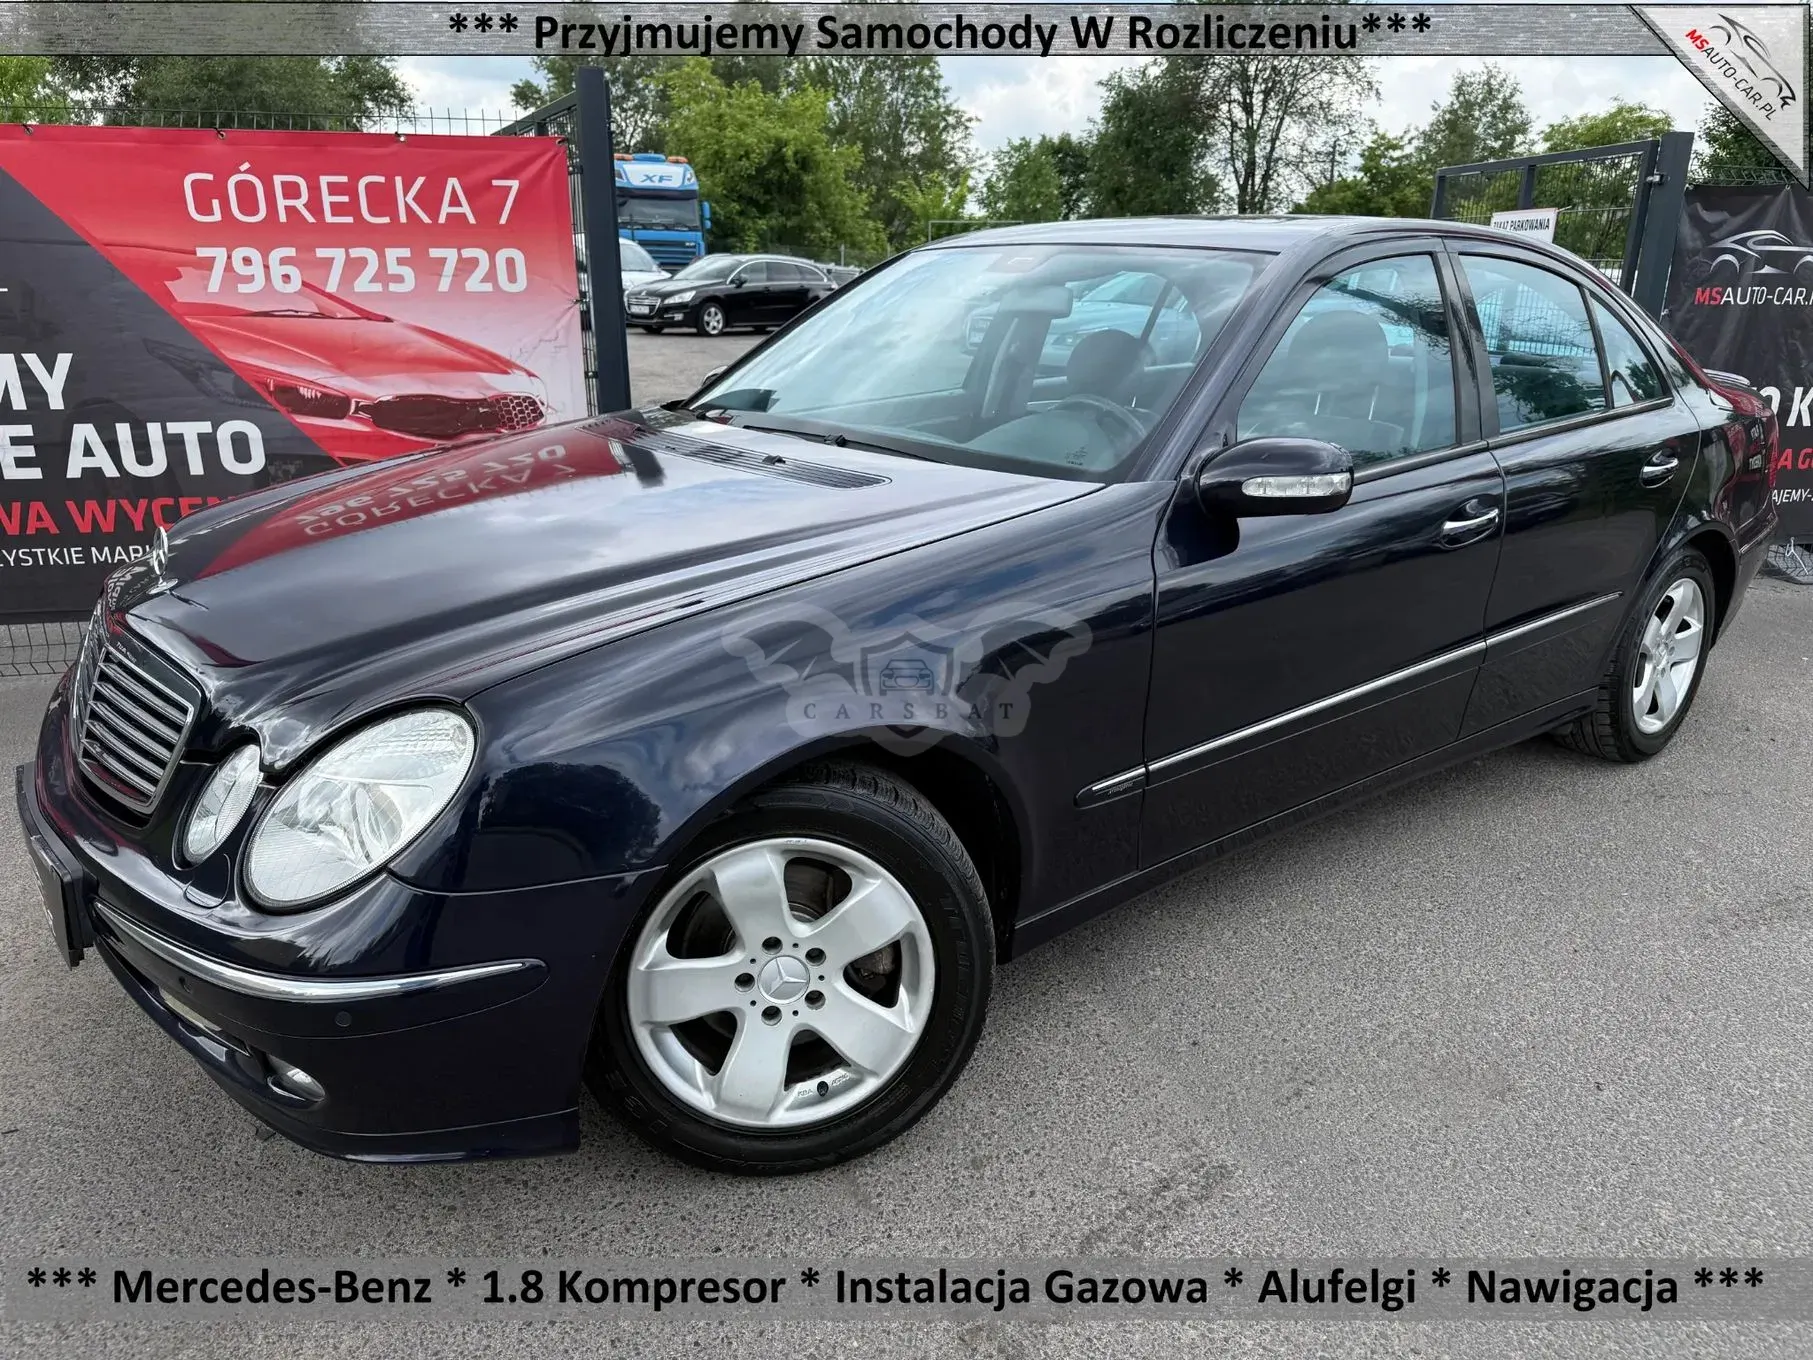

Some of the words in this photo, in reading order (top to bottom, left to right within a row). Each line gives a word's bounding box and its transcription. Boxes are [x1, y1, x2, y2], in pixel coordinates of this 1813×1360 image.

[640, 174, 673, 184] XF
[183, 161, 477, 225] GÓRECKA
[491, 179, 520, 225] 7
[1509, 217, 1550, 232] PARKOWANIA
[195, 246, 303, 294] 796
[315, 246, 416, 294] 725
[428, 246, 528, 294] 720
[1694, 286, 1813, 306] MSAUTO-CAR.
[66, 419, 266, 479] AUTO
[1772, 488, 1813, 506] AJEMY-
[65, 496, 236, 533] WYCE
[0, 547, 85, 567] YSTKIE
[91, 545, 151, 564] MAR
